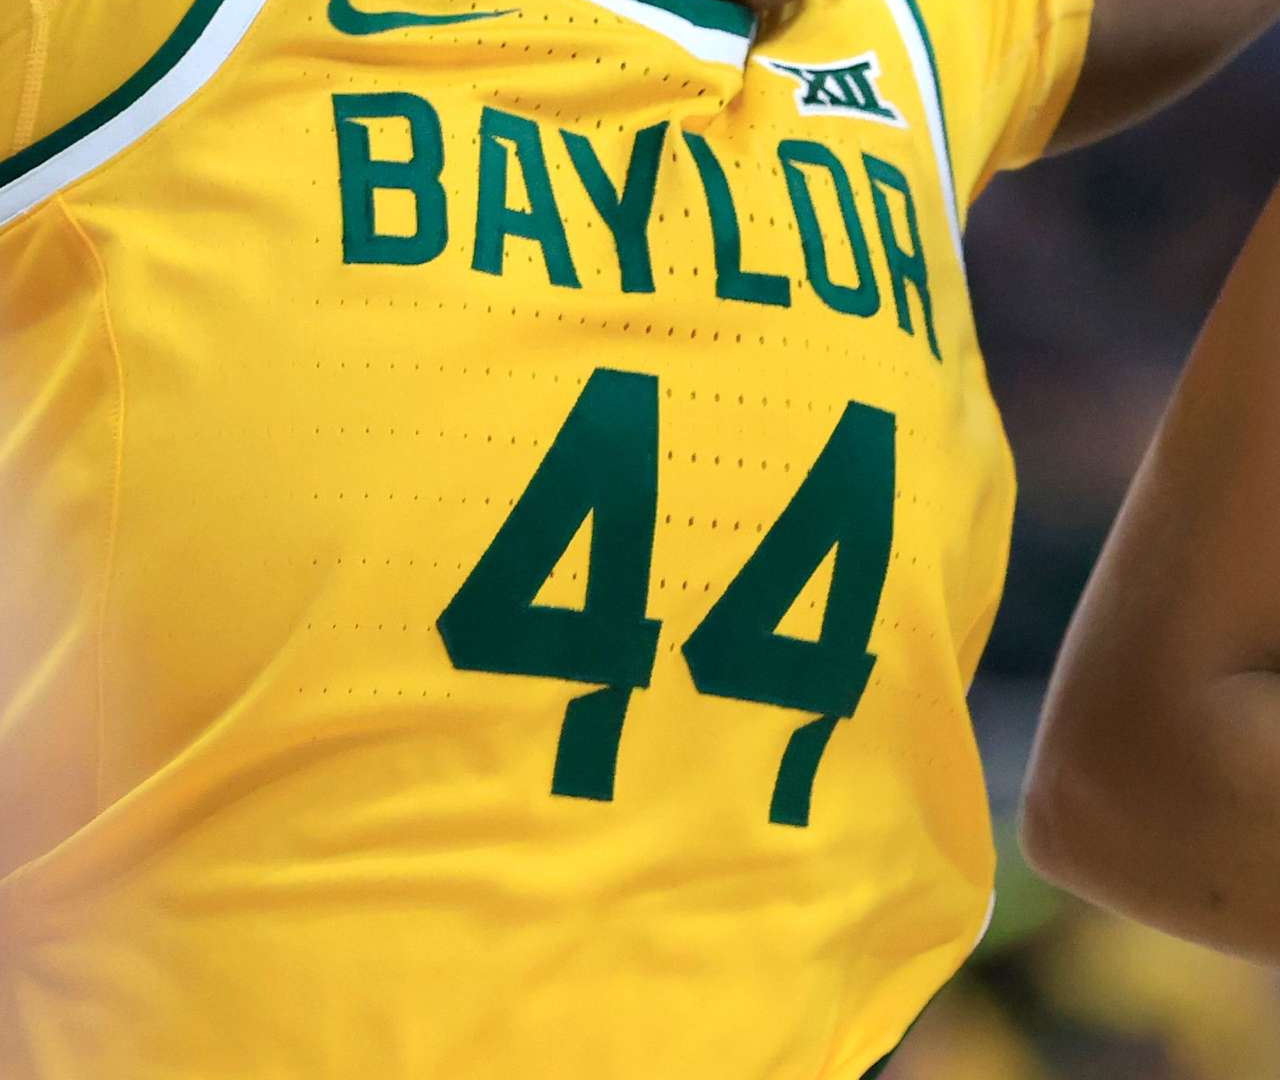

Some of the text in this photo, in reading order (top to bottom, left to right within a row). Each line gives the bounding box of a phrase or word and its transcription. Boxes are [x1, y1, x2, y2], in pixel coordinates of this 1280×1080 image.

[768, 60, 898, 121] XII
[331, 91, 943, 362] BAYLOR
[435, 366, 897, 828] 44
